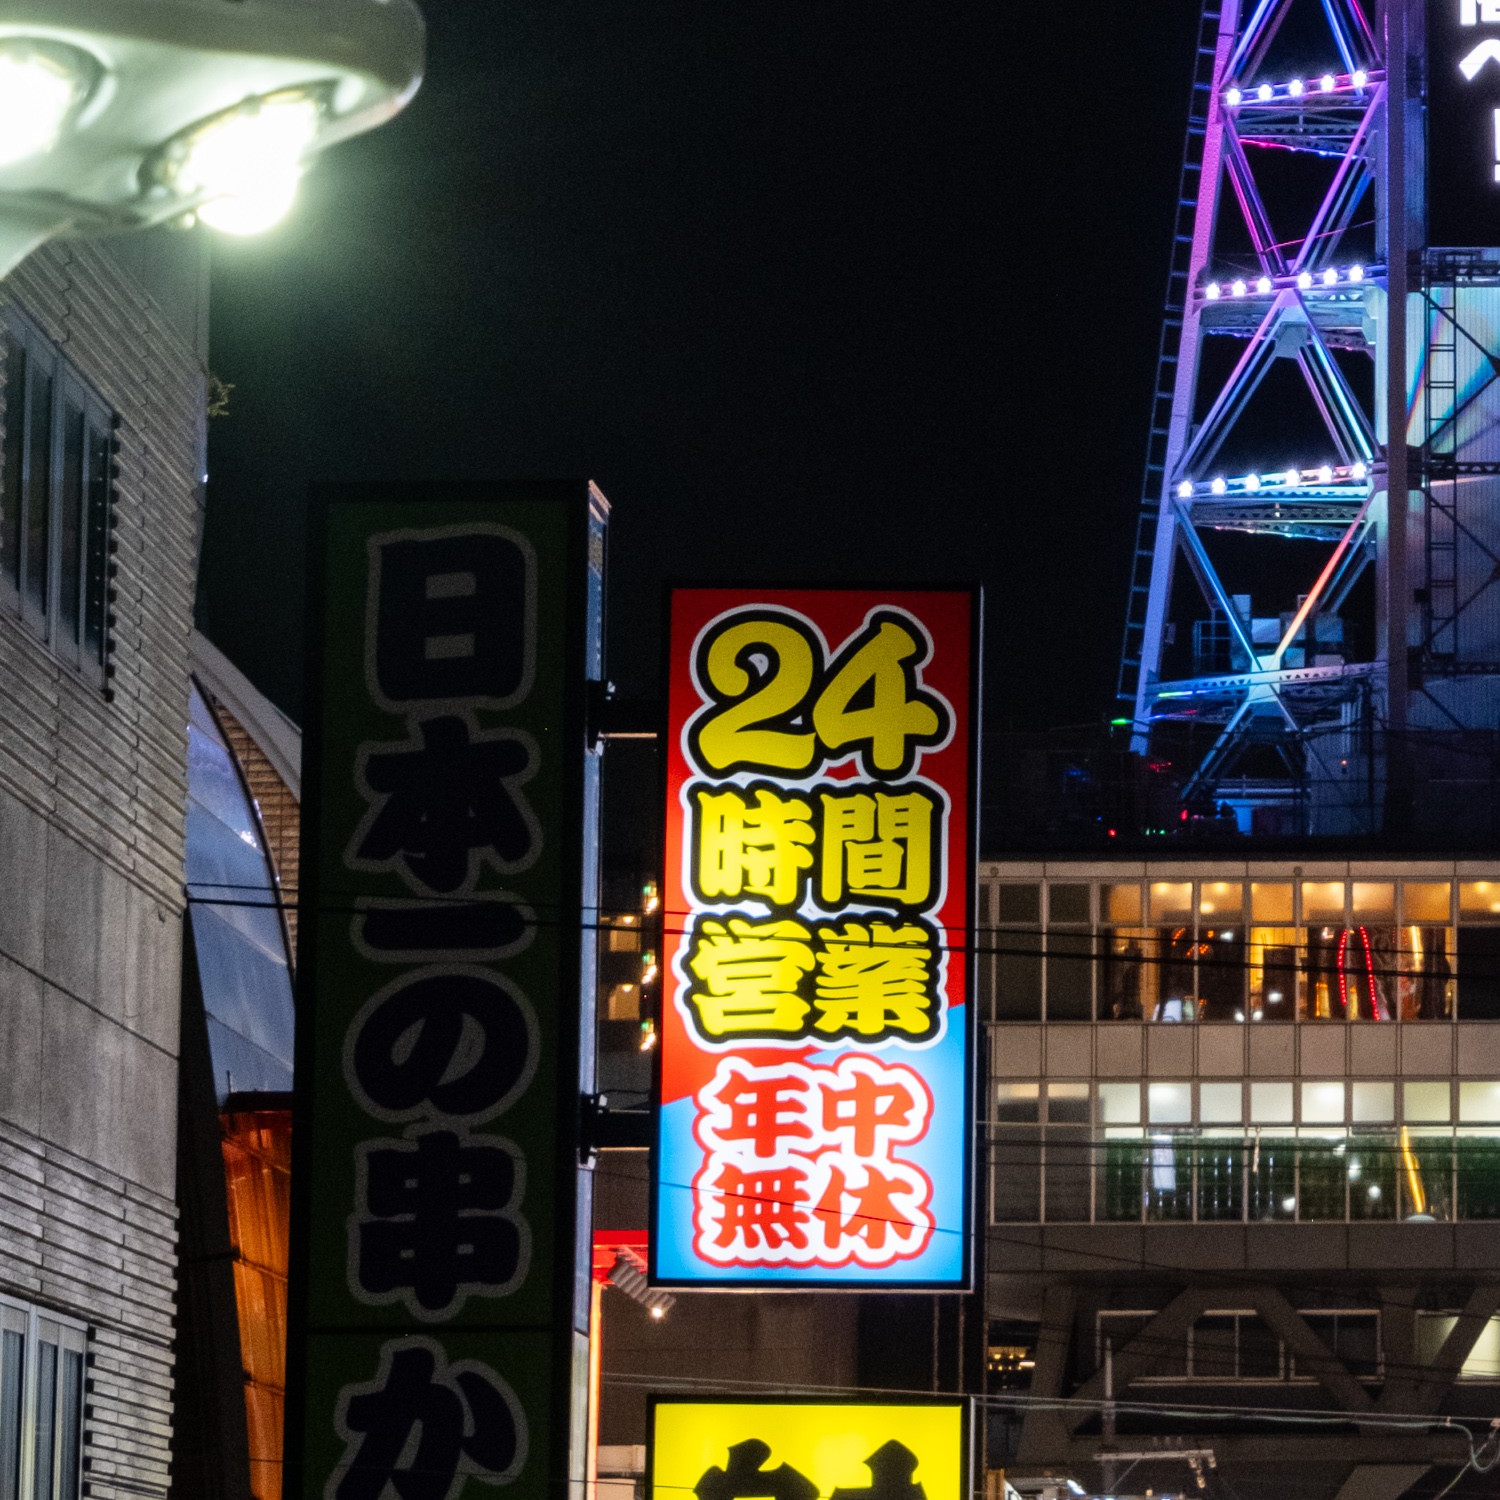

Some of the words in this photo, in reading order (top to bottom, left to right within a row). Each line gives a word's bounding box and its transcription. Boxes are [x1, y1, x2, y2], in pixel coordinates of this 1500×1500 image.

[690, 608, 944, 776] 24
[686, 782, 944, 911] 時間
[680, 913, 941, 1042] 営業
[709, 1068, 913, 1159] 年中
[709, 1162, 916, 1248] 無休
